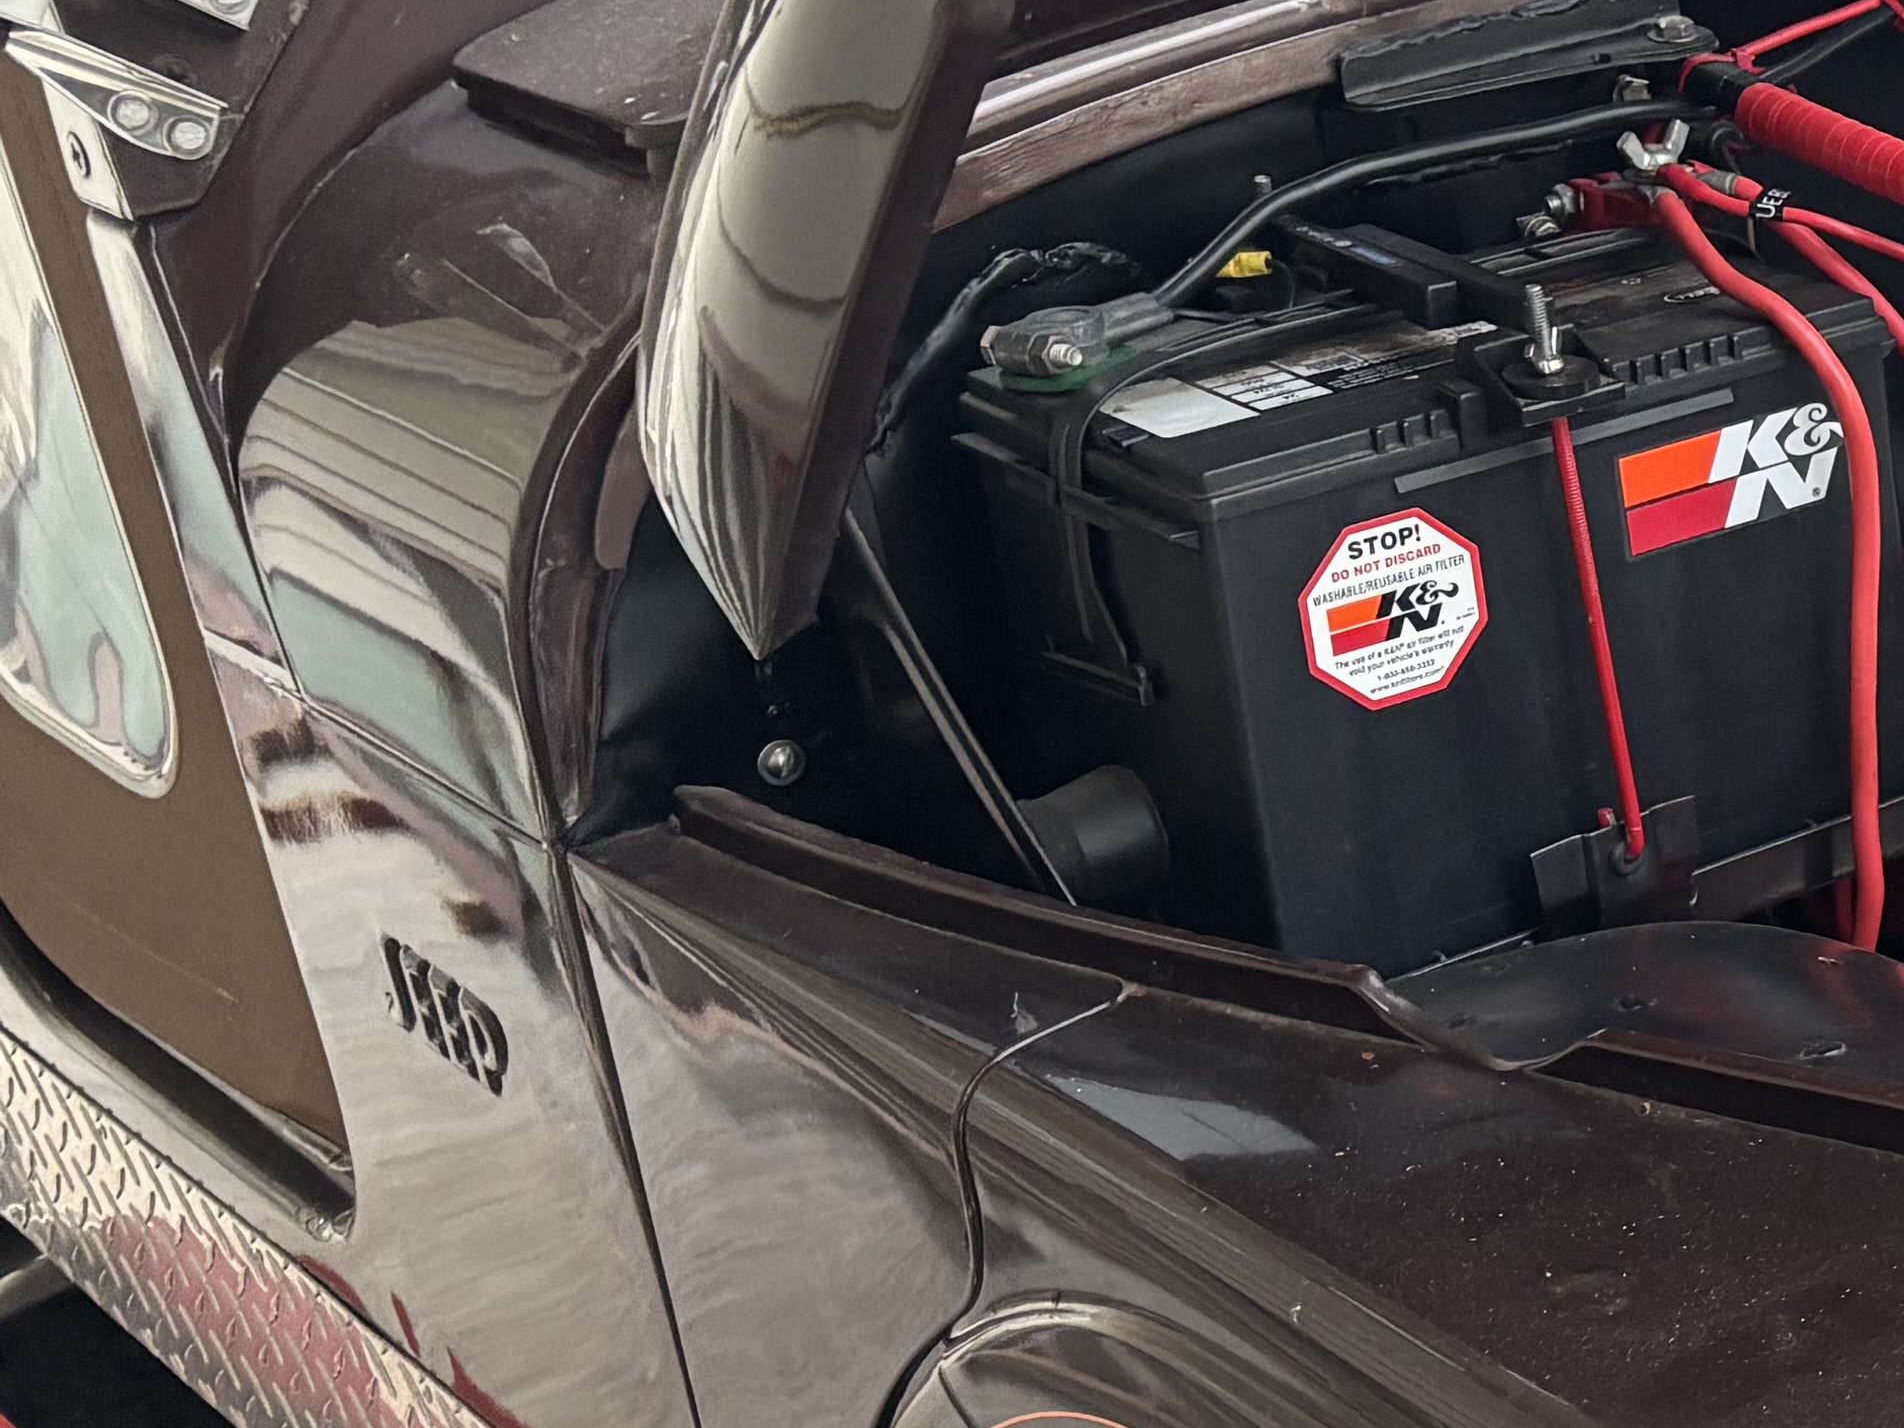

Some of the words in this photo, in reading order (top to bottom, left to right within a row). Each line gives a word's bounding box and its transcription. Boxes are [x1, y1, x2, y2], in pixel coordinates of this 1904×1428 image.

[1331, 569, 1349, 583] DO
[1354, 560, 1381, 577] NOT
[1385, 543, 1441, 568] DISCARD
[1348, 524, 1420, 560] STOP!
[1313, 567, 1415, 607] WASHABLE/REUSABLE
[1417, 564, 1434, 577] AIR
[1435, 554, 1465, 572] FILTER
[1377, 580, 1460, 640] K&N
